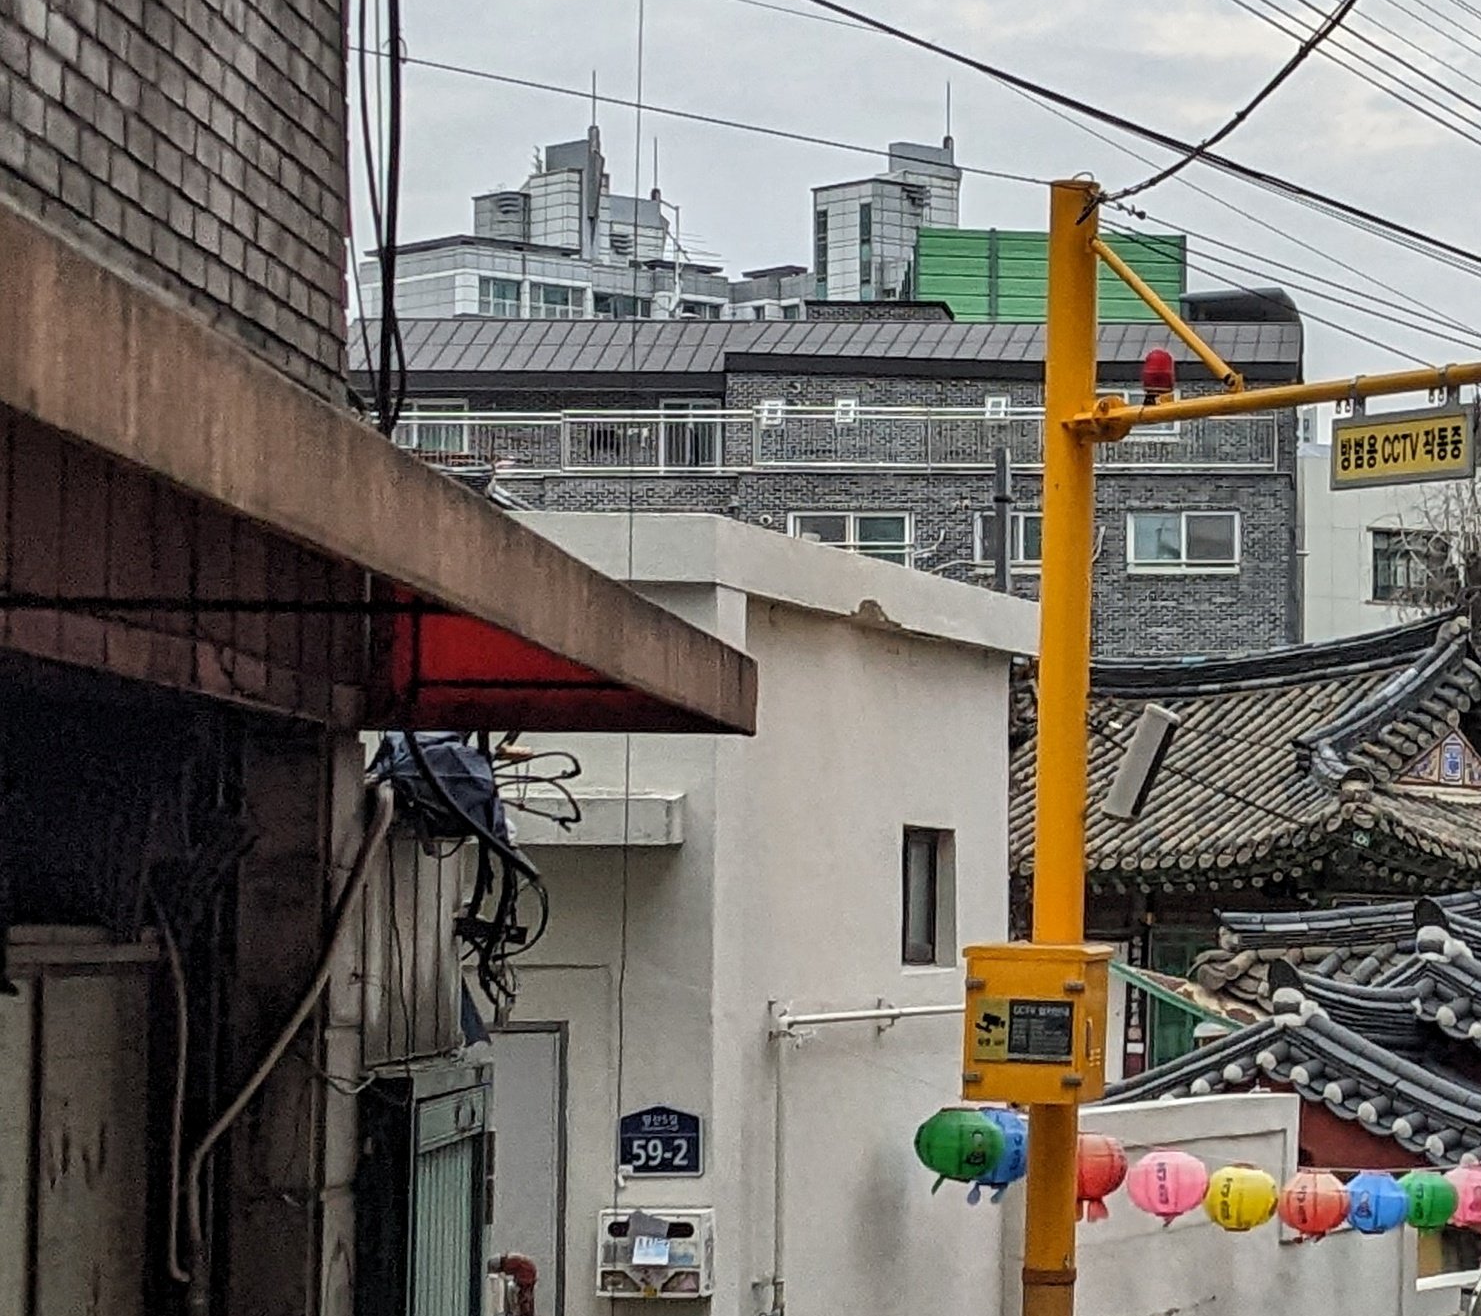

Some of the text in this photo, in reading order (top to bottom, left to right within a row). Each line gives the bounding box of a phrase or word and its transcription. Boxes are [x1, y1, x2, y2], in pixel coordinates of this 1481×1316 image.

[1340, 425, 1463, 472] 방범용 CCTV 작동중
[632, 1138, 689, 1167] 59-2
